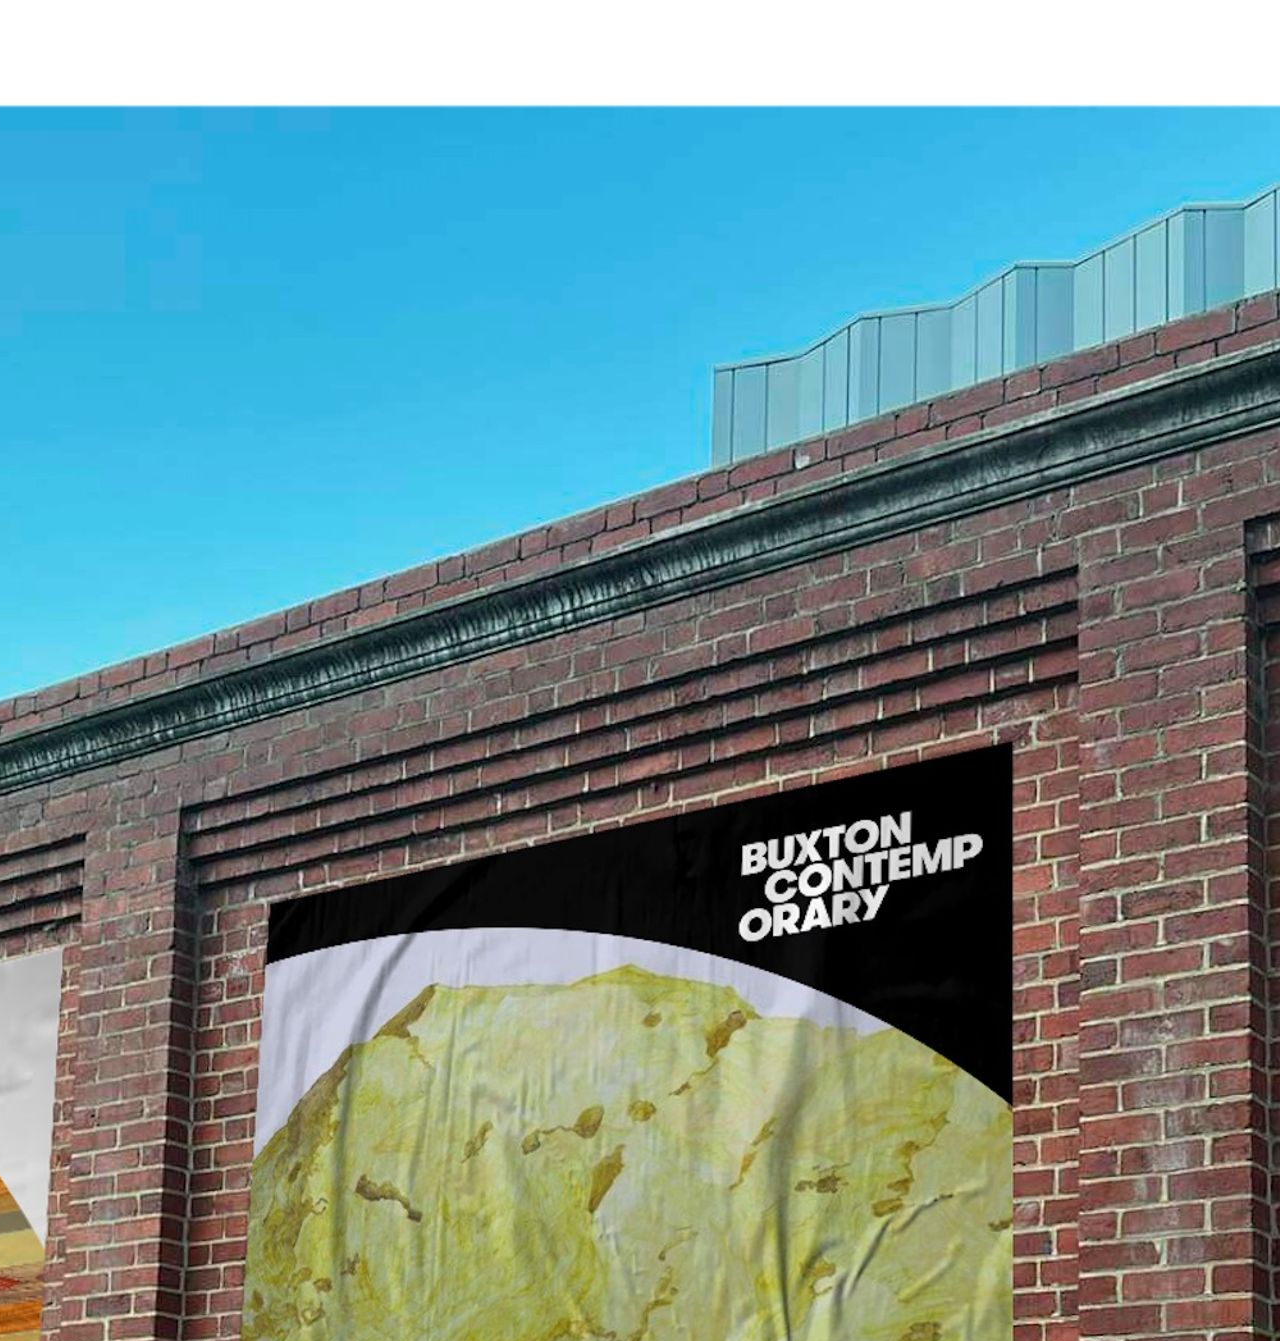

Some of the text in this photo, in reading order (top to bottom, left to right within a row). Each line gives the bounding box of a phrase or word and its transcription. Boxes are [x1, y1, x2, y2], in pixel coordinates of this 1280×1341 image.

[741, 811, 912, 876] BUXTON
[764, 833, 983, 903] CONTEMP
[738, 884, 890, 942] ORARY
